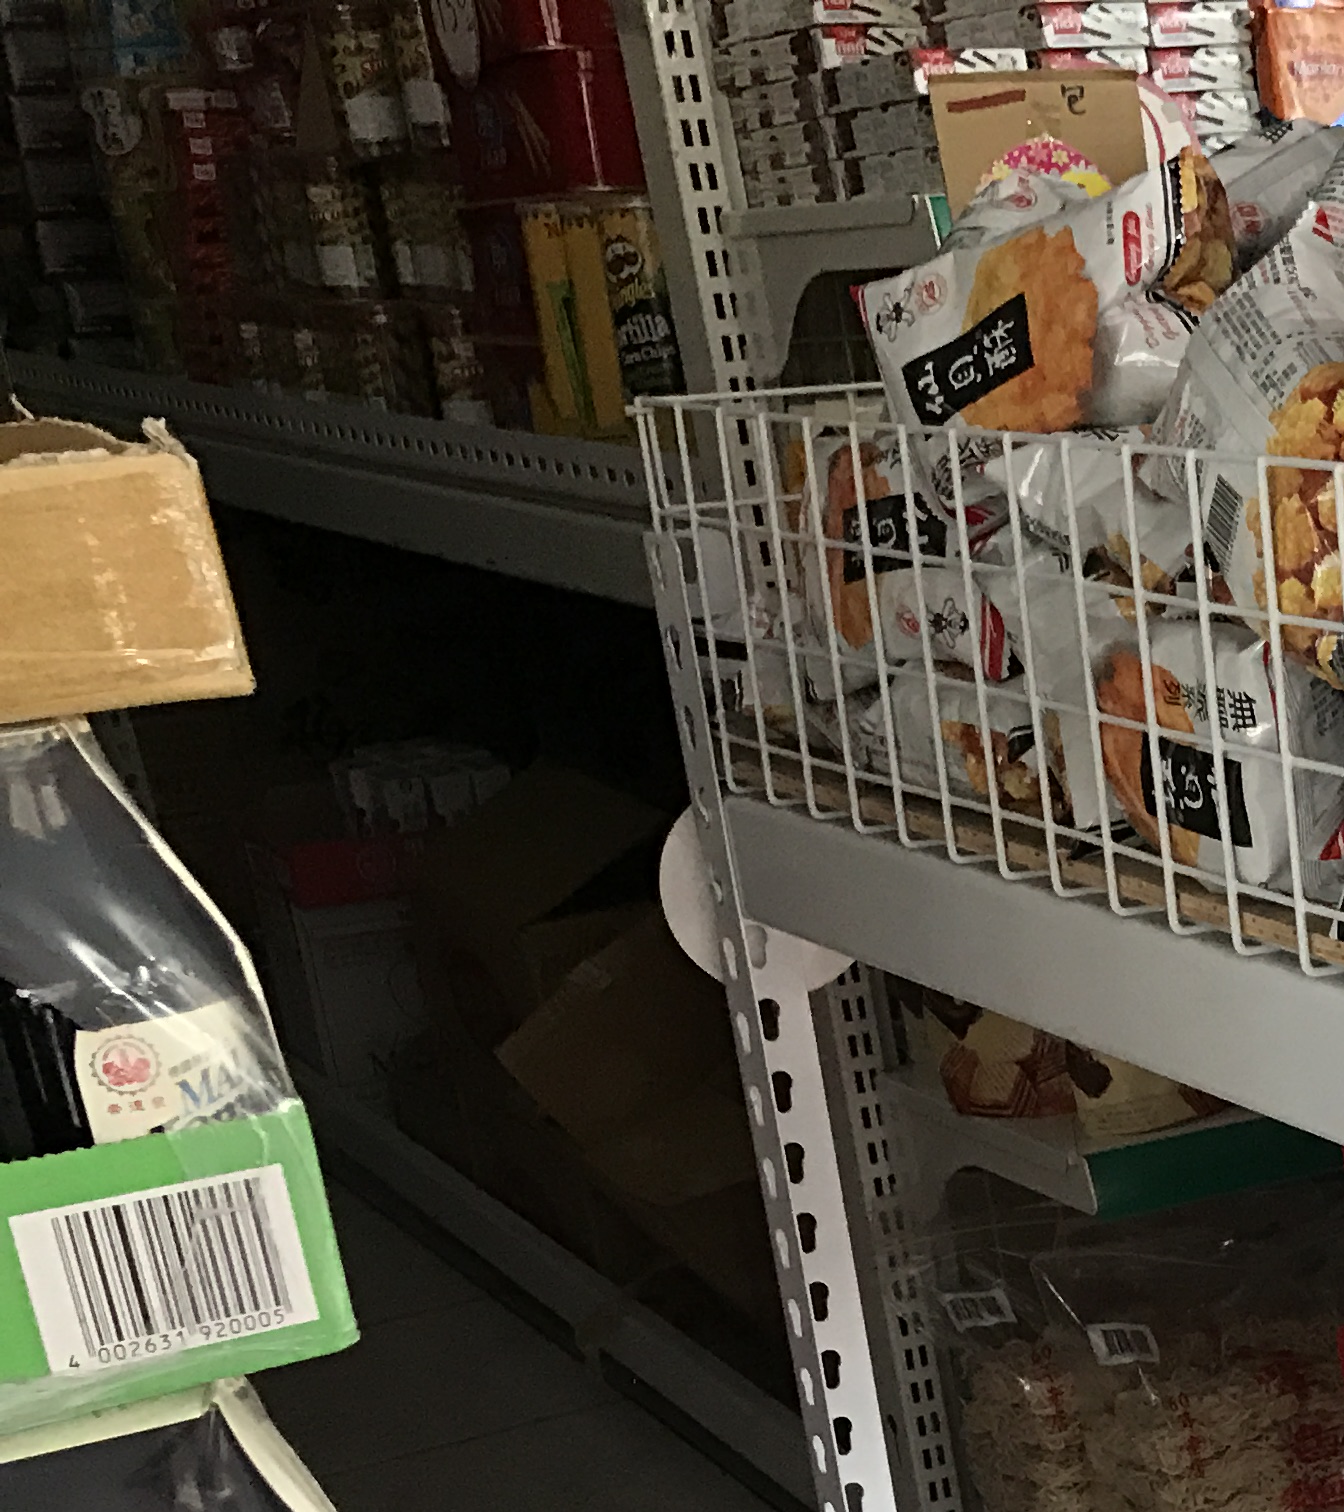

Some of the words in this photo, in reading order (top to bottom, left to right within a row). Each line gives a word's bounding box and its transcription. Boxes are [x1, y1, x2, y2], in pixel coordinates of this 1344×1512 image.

[68, 1353, 81, 1371] 4
[97, 1330, 188, 1366] 002631
[198, 1307, 287, 1342] 920005
